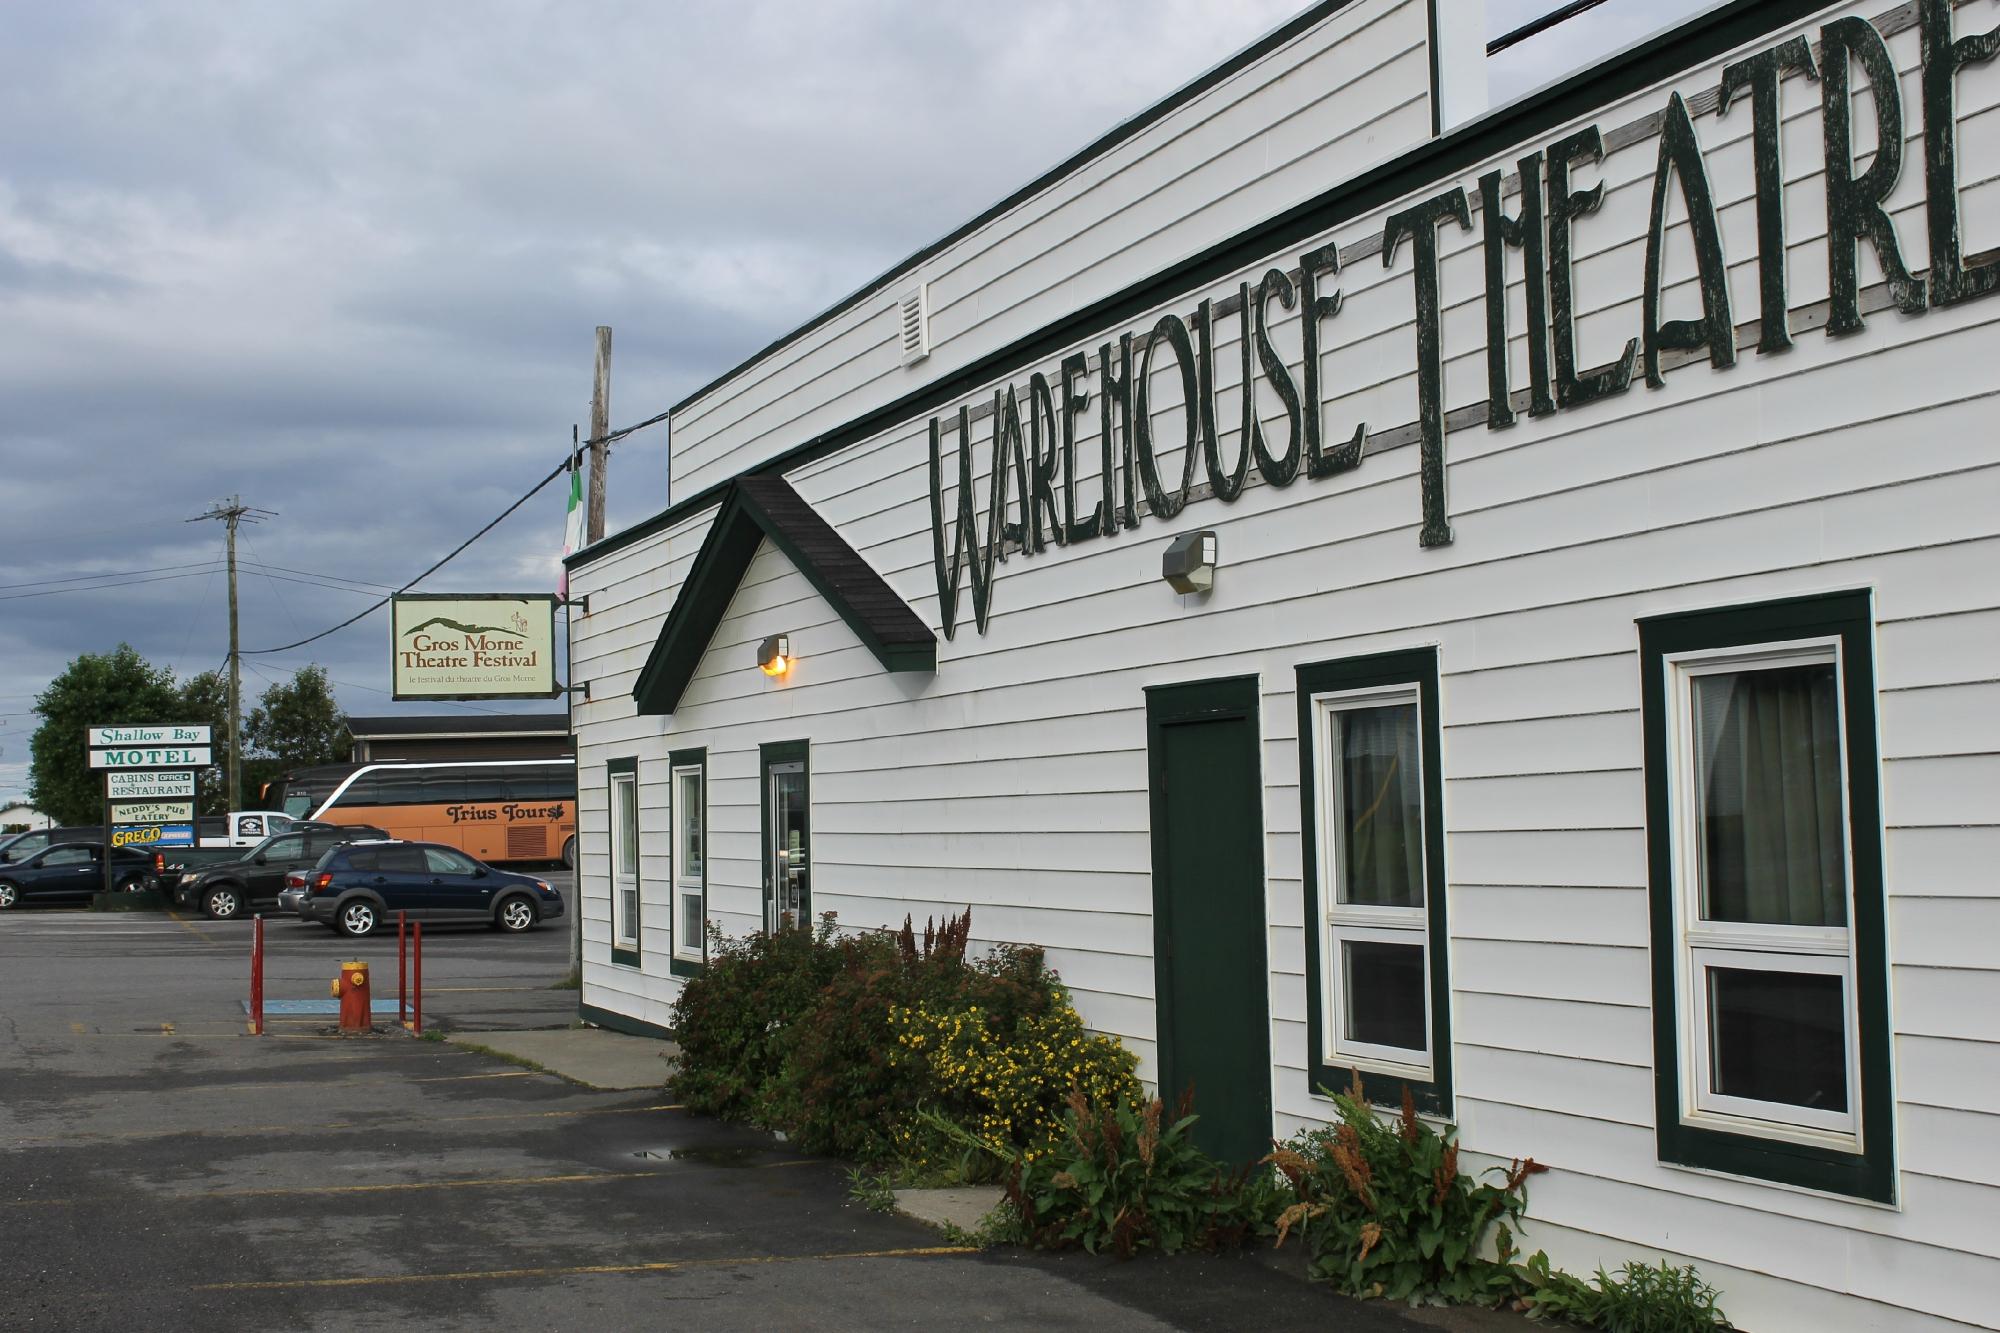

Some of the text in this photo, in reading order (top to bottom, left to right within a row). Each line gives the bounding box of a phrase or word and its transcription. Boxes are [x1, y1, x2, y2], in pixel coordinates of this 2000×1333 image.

[929, 241, 1371, 642] WAREHOUSE
[413, 634, 524, 651] Gros Morne
[400, 650, 537, 668] Theatre Festival
[494, 674, 511, 682] Gros
[101, 729, 200, 744] Shallow Bay
[105, 750, 196, 765] MOTEL
[111, 774, 154, 783] CABINS
[112, 786, 191, 796] RESTAURANT
[119, 804, 185, 815] NEDDY'S PUB
[135, 813, 170, 821] EATERY
[446, 805, 498, 824] Trius
[112, 828, 161, 846] GRECO
